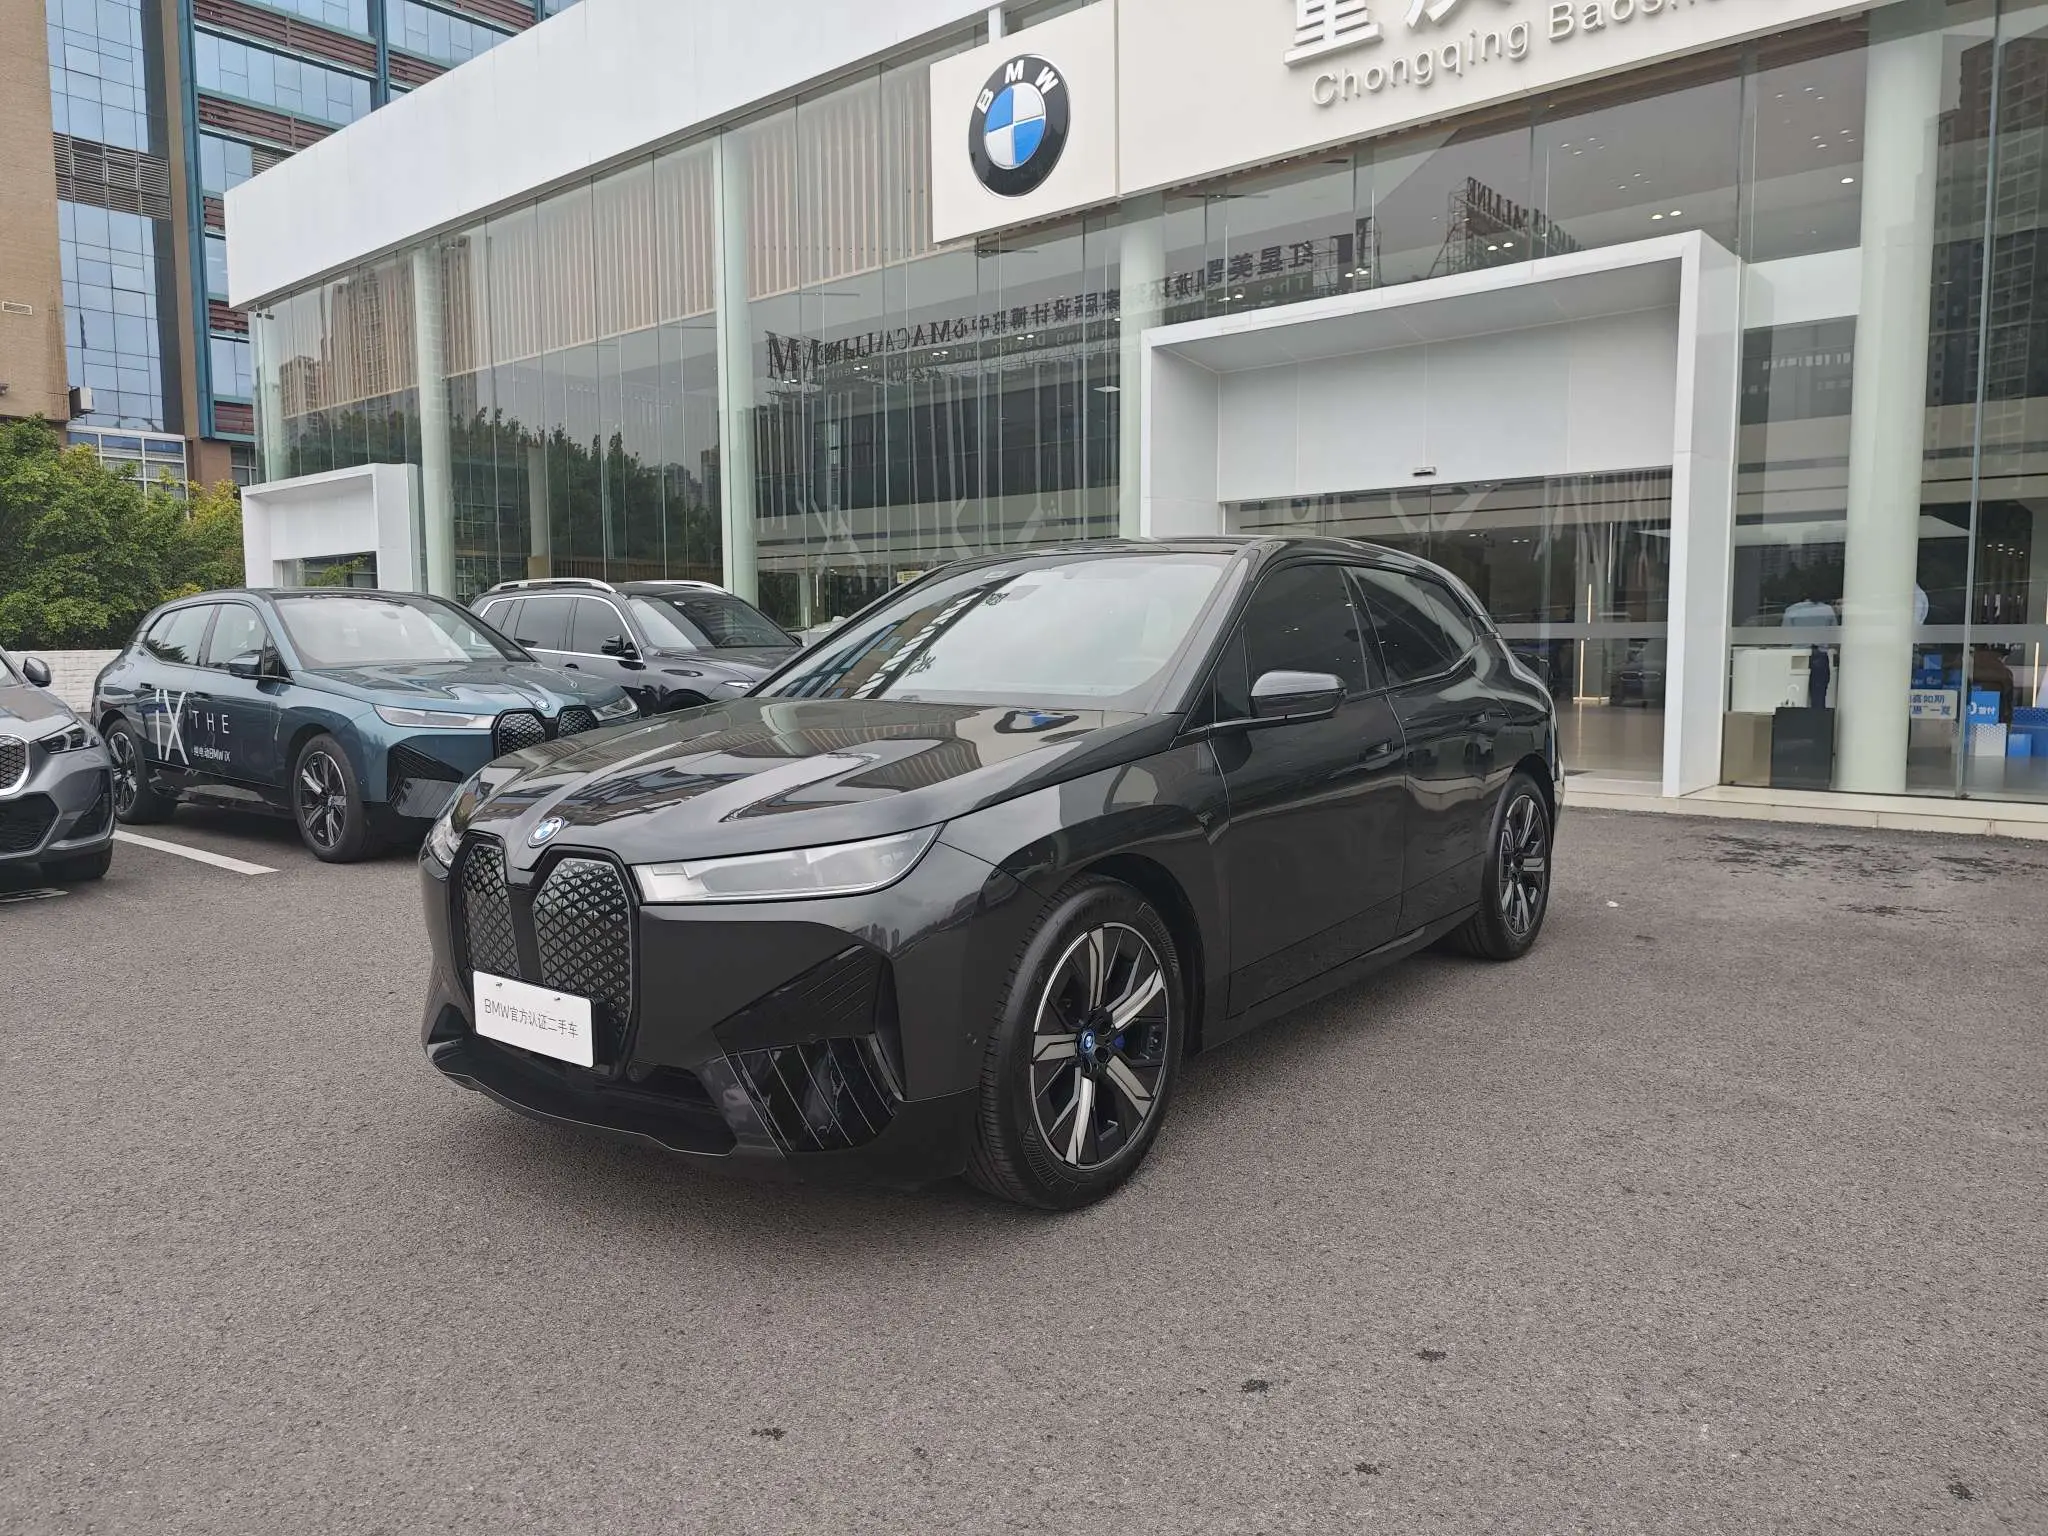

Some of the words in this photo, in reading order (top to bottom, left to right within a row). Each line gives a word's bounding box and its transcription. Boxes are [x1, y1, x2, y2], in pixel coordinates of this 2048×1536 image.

[975, 59, 1060, 115] BMW
[1311, 21, 1530, 106] Chongqing
[192, 710, 230, 734] THE
[484, 998, 579, 1038] BMW官方认证二手车
